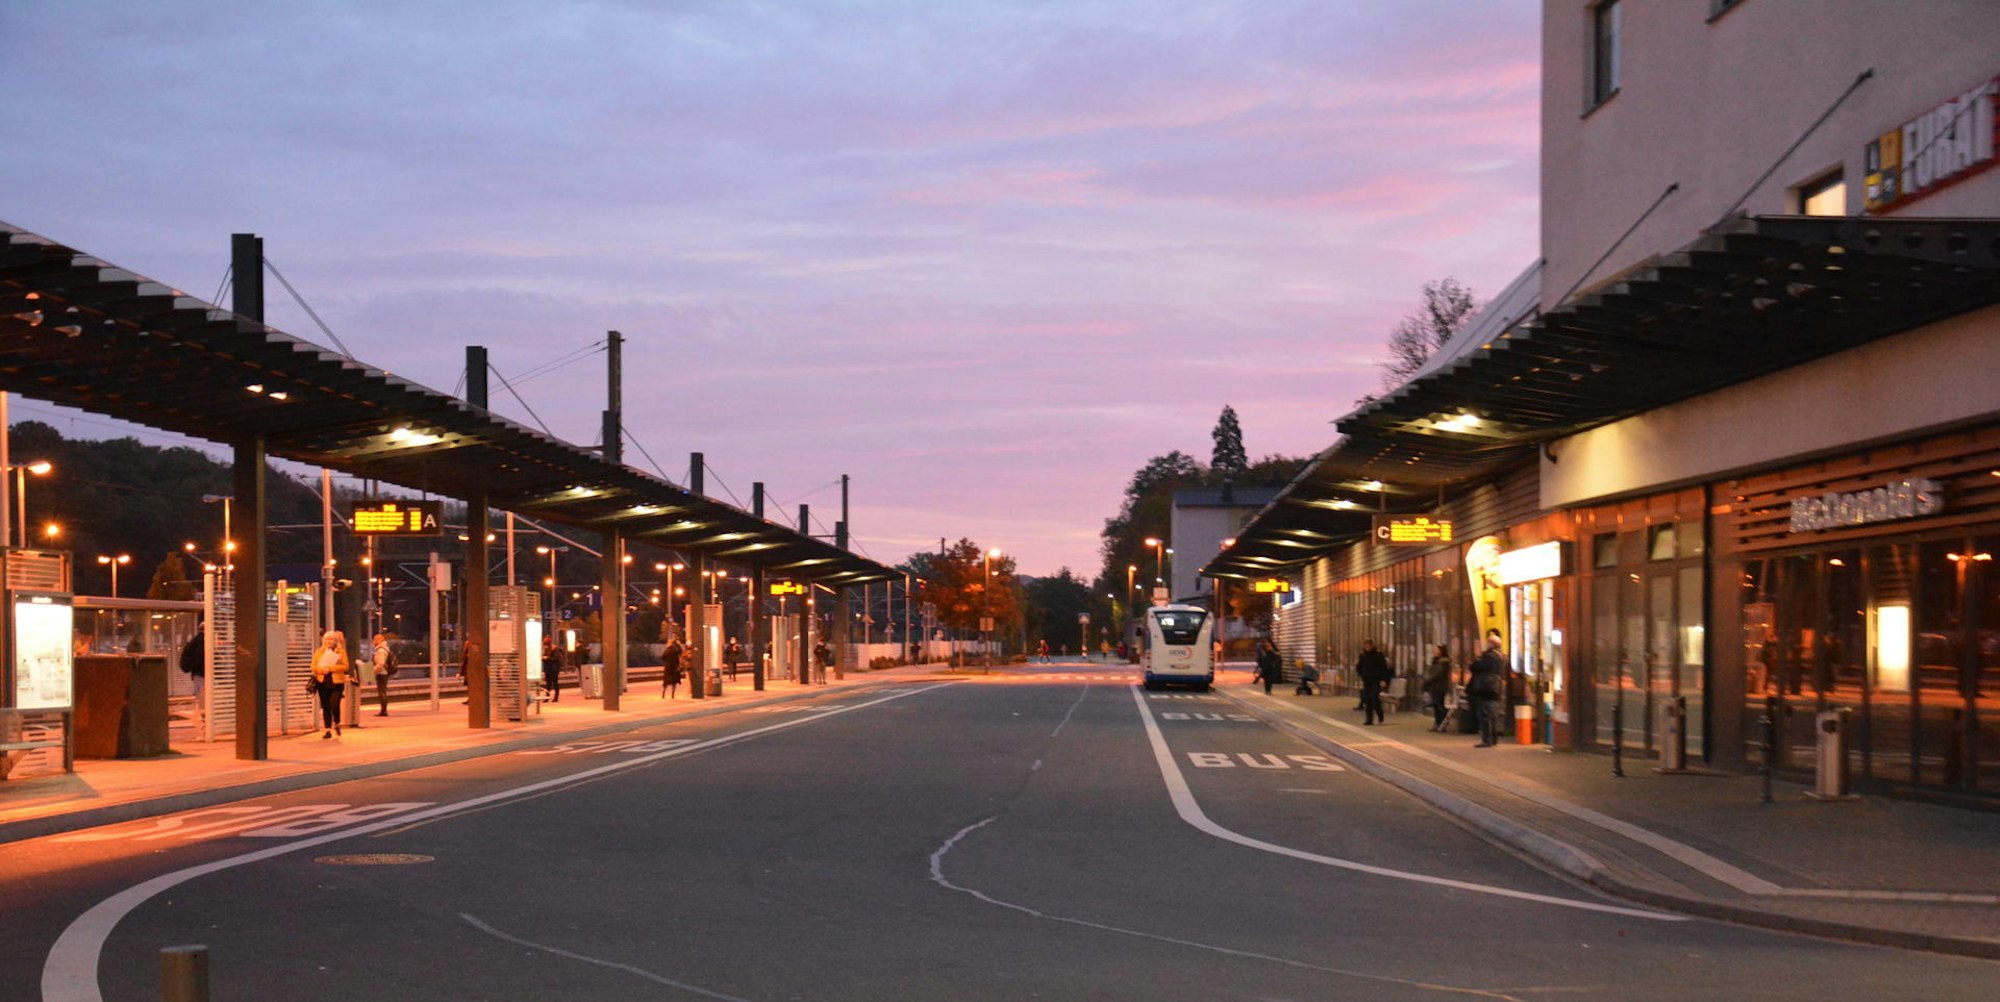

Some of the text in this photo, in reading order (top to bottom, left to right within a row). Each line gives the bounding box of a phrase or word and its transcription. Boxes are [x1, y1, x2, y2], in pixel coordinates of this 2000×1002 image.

[1790, 477, 1943, 533] McDonald's
[423, 513, 437, 528] A
[1377, 526, 1390, 539] C
[564, 610, 572, 619] 2
[1161, 712, 1259, 722] BUS
[1187, 752, 1345, 772] BUS
[48, 802, 438, 843] BUS
